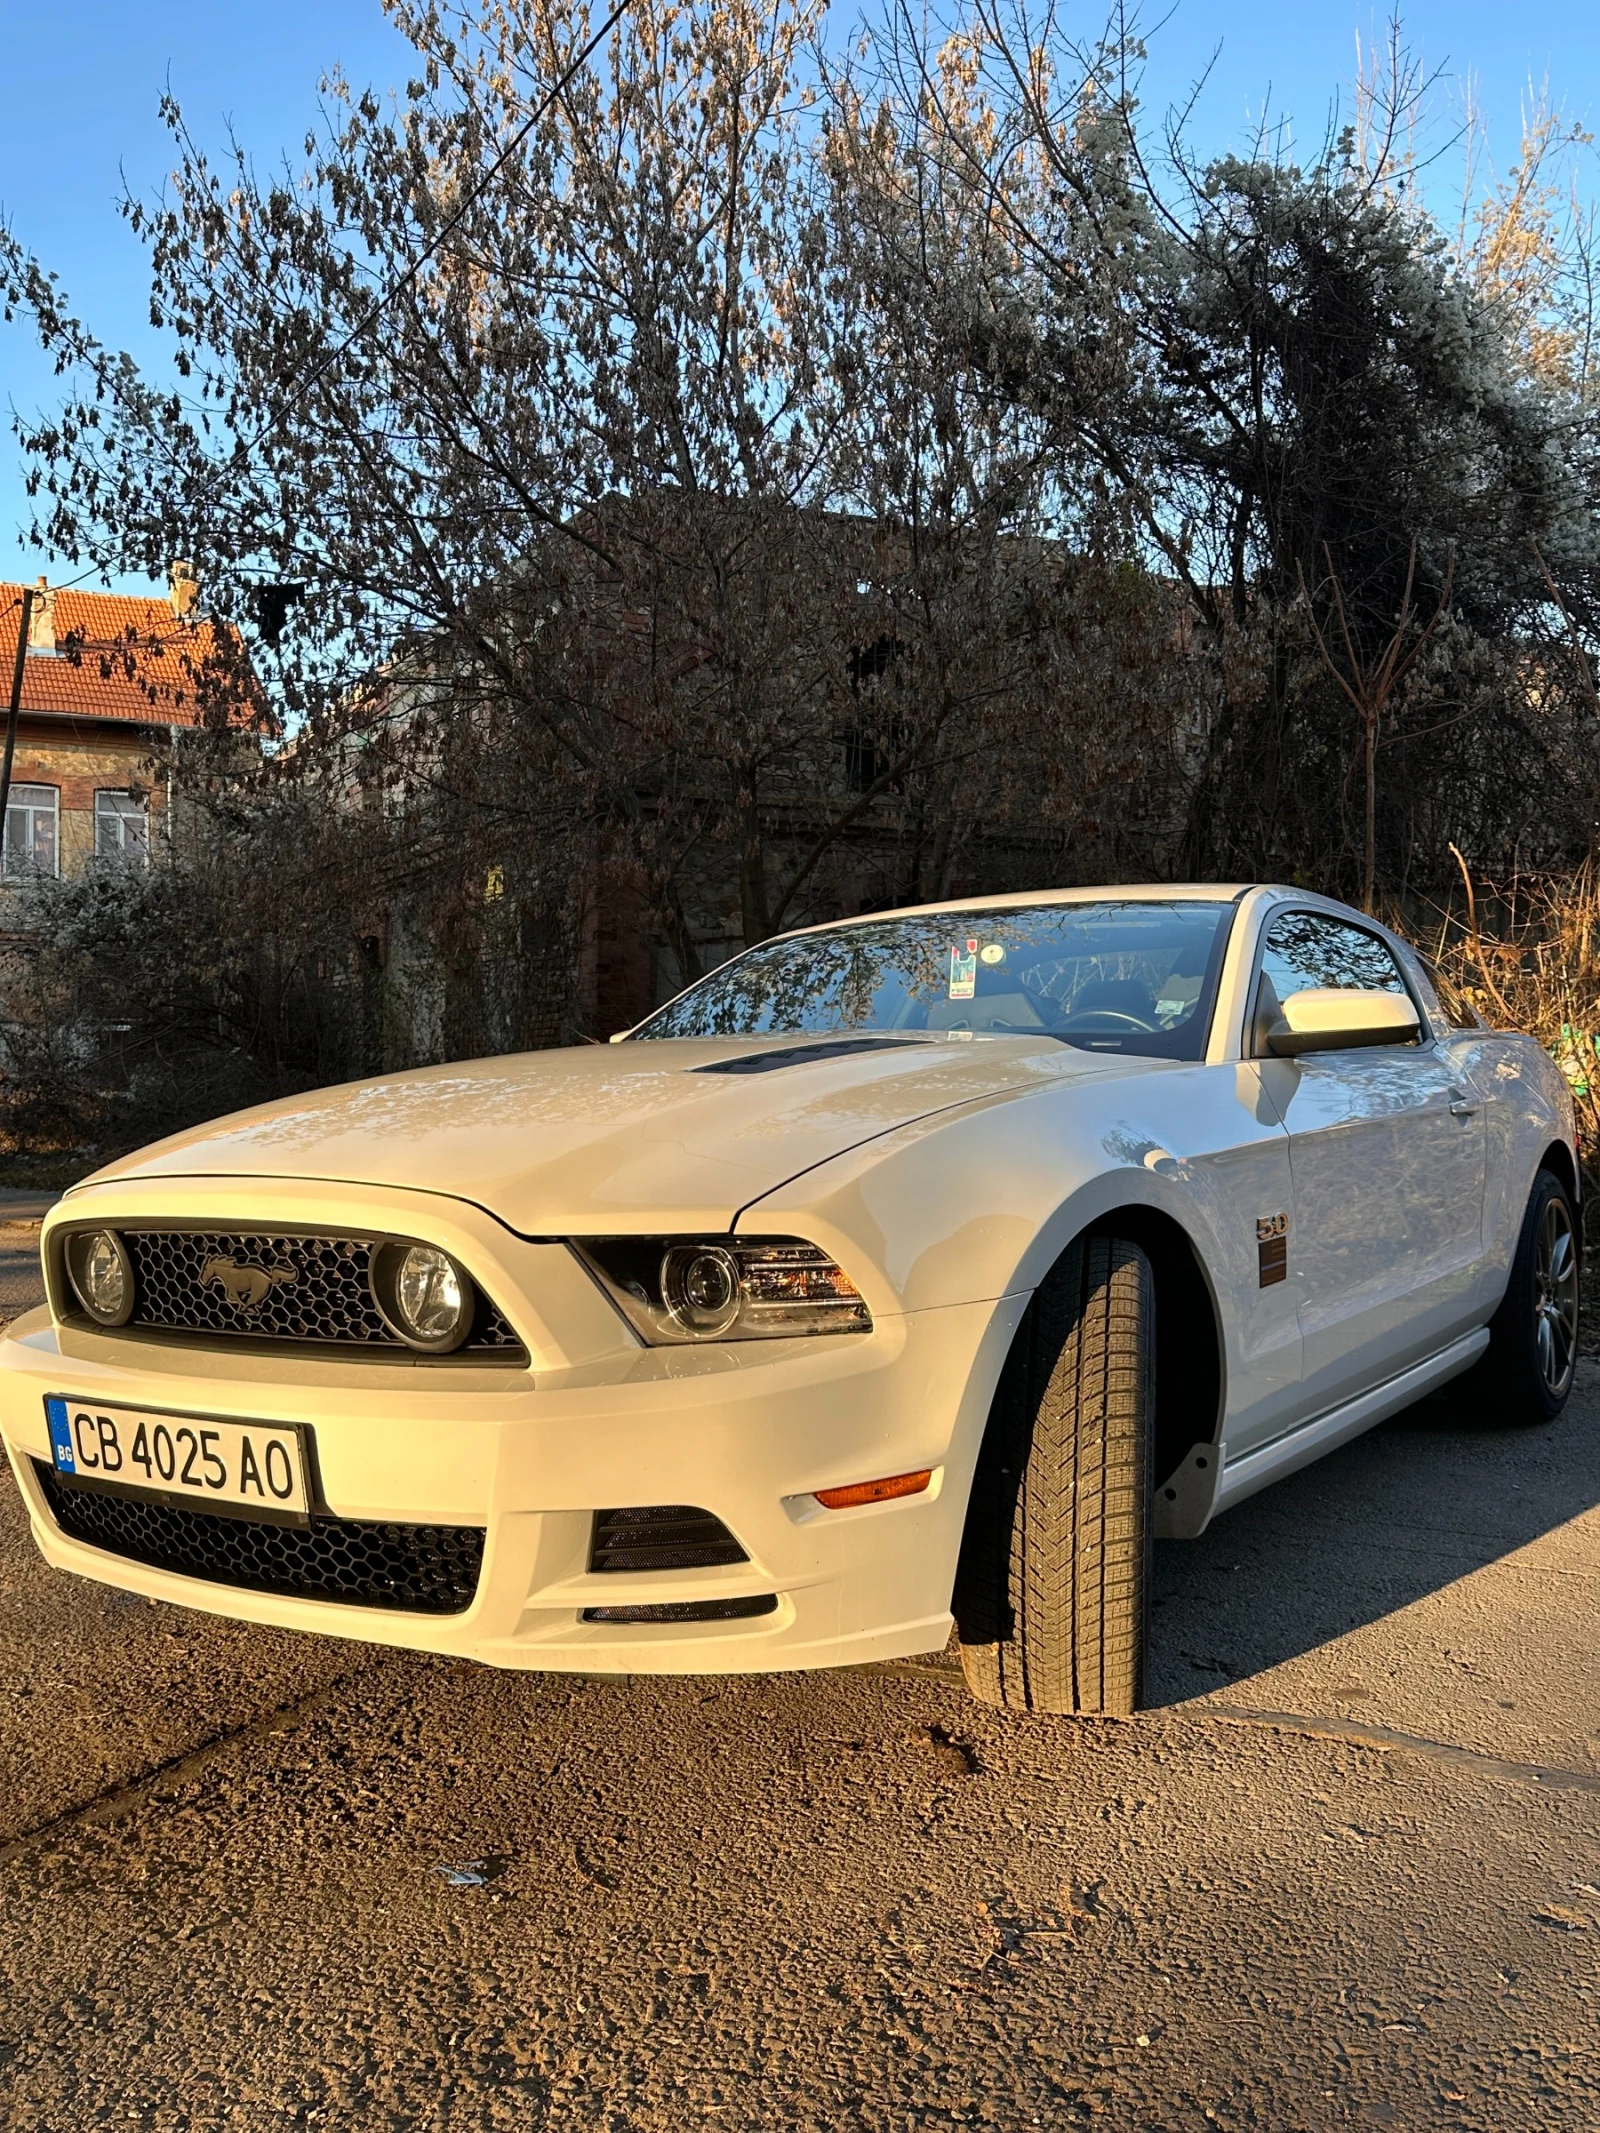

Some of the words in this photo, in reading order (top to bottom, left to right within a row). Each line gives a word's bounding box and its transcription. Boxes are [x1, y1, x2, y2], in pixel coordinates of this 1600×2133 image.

[57, 1444, 73, 1463] BG
[74, 1413, 123, 1471] CB
[131, 1422, 227, 1489] 4025
[240, 1435, 293, 1499] AO
